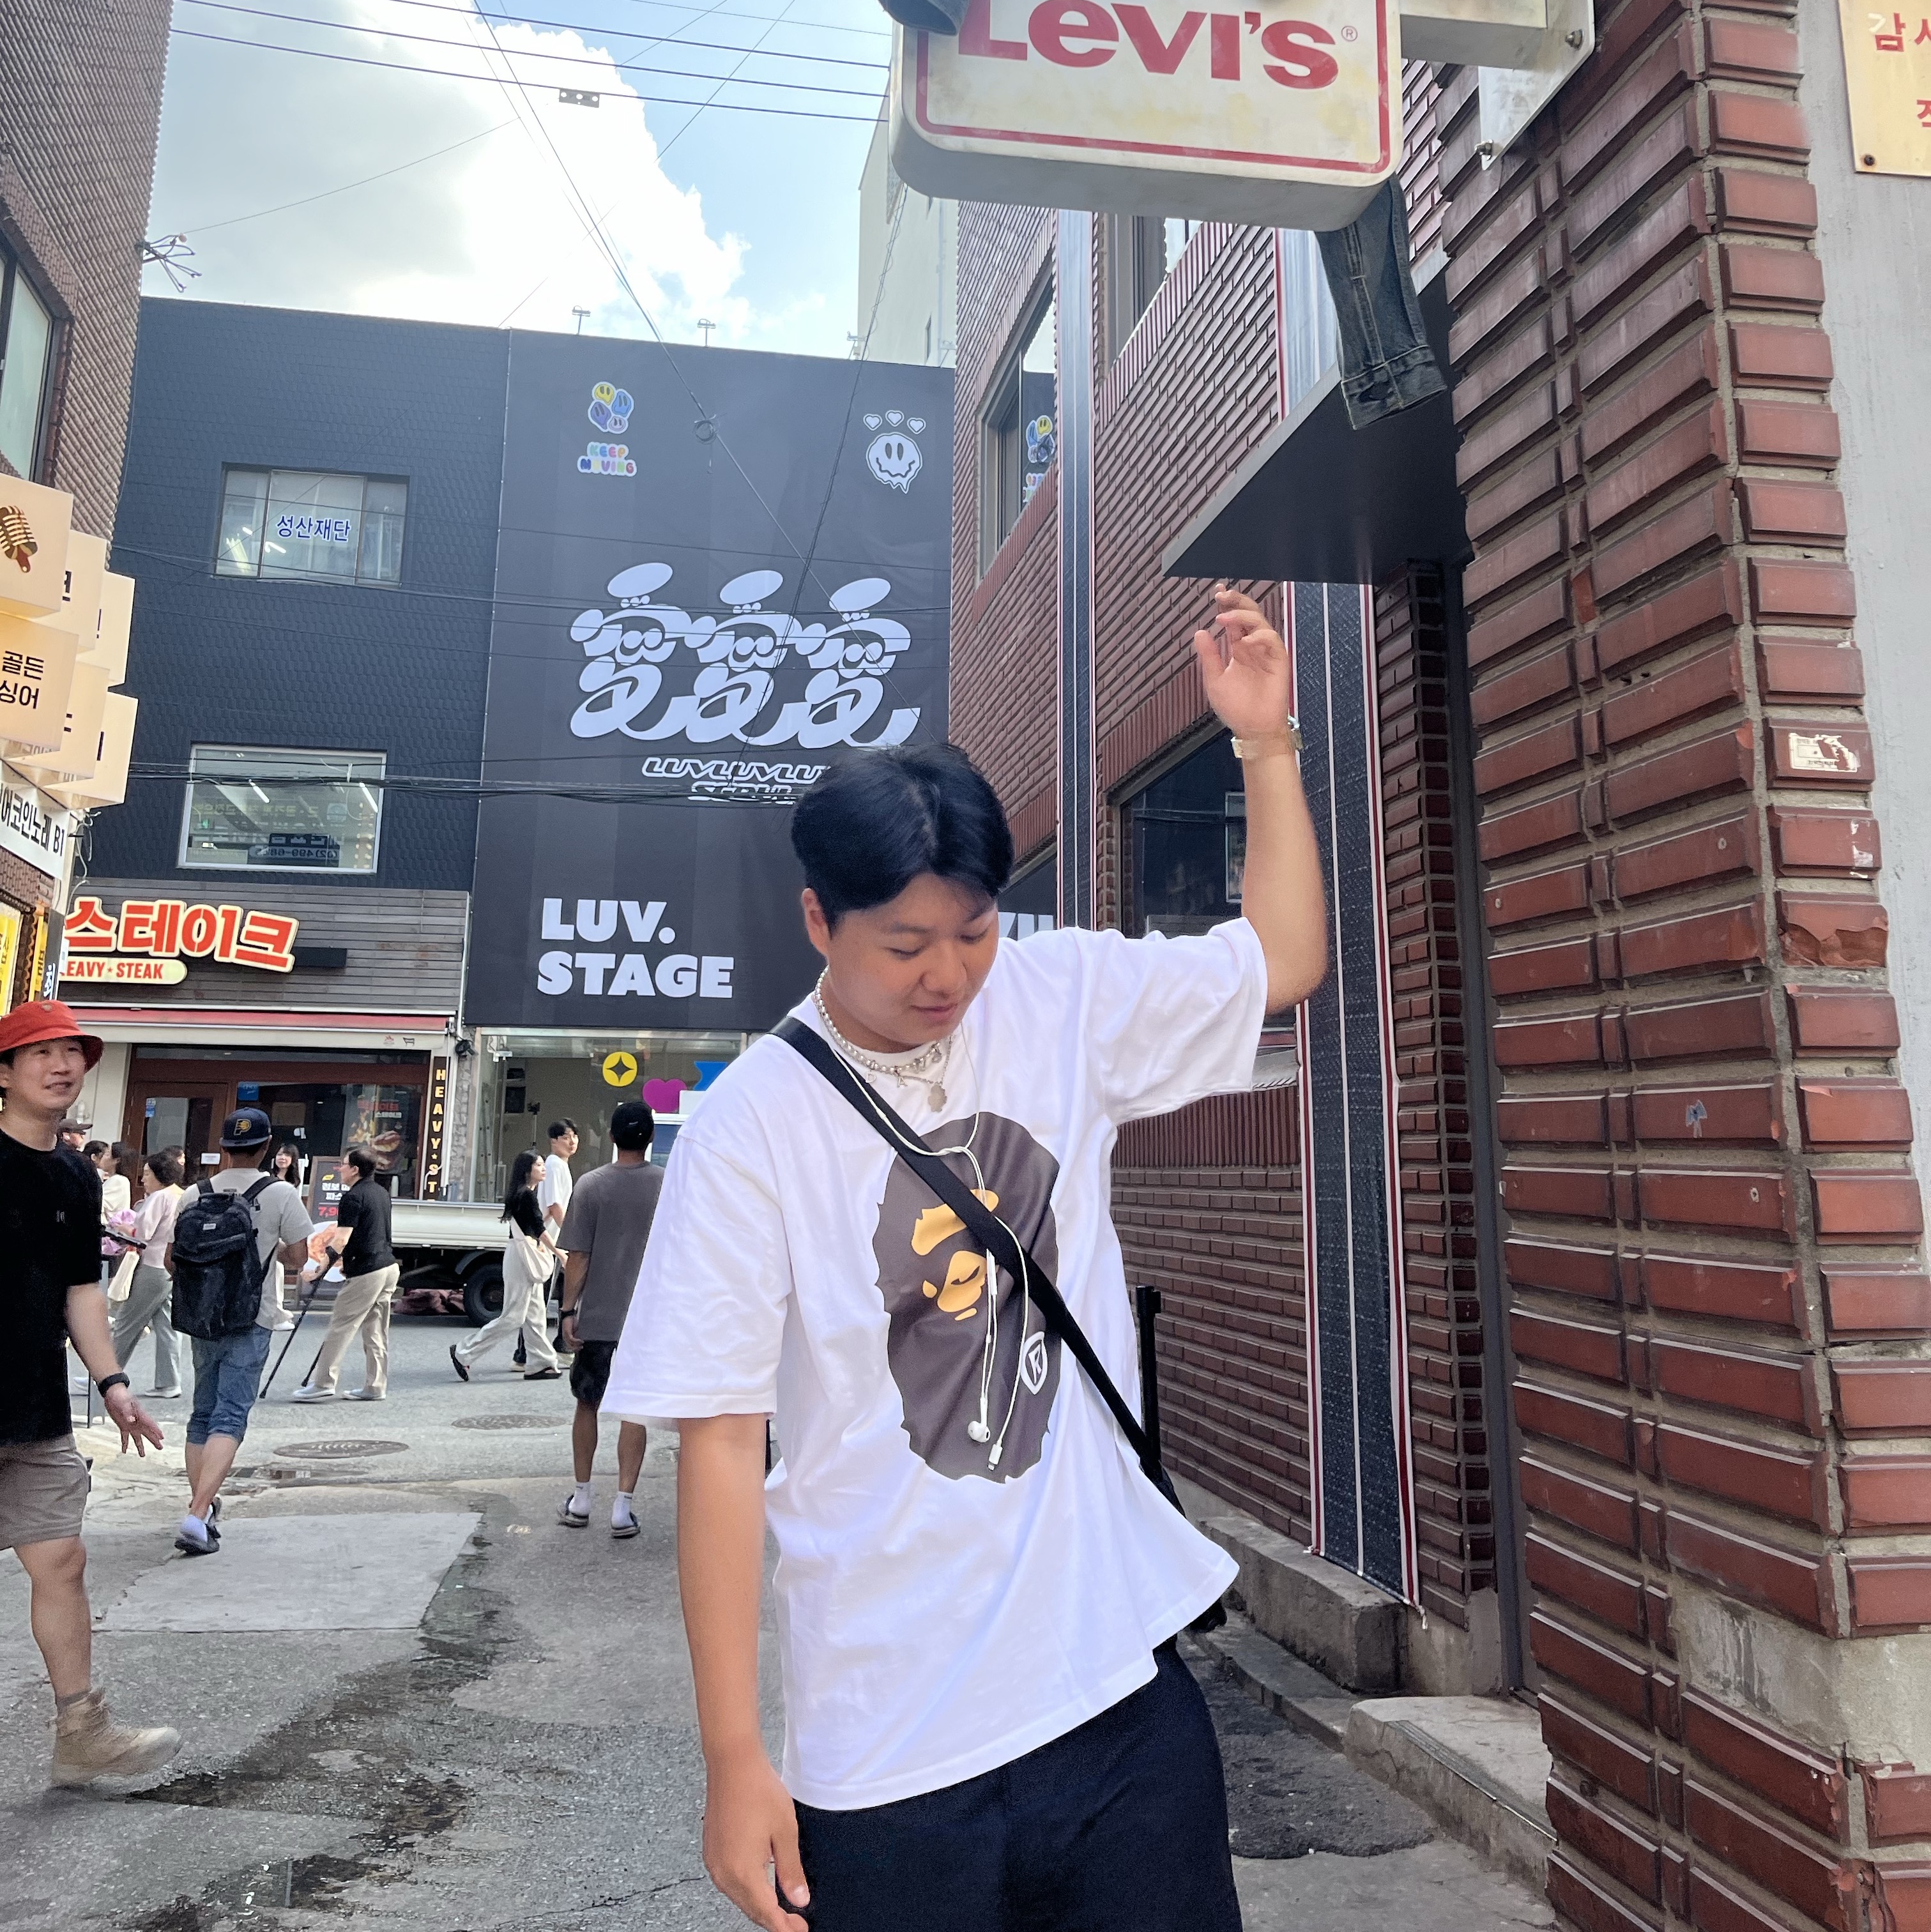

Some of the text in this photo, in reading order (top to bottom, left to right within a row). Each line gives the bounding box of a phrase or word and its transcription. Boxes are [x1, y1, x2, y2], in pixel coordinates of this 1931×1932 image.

[579, 457, 636, 475] MOVING
[588, 443, 627, 459] KEEP
[276, 514, 351, 542] 성산재단
[2, 650, 44, 680] 골든
[0, 680, 40, 709] 싱어
[53, 825, 65, 856] B1
[65, 897, 296, 971] 스테이크
[541, 898, 676, 944] LUV.
[61, 961, 105, 978] EAVY
[116, 962, 163, 979] STEAK
[537, 950, 734, 998] STAGE
[431, 1069, 446, 1150] HEAVY
